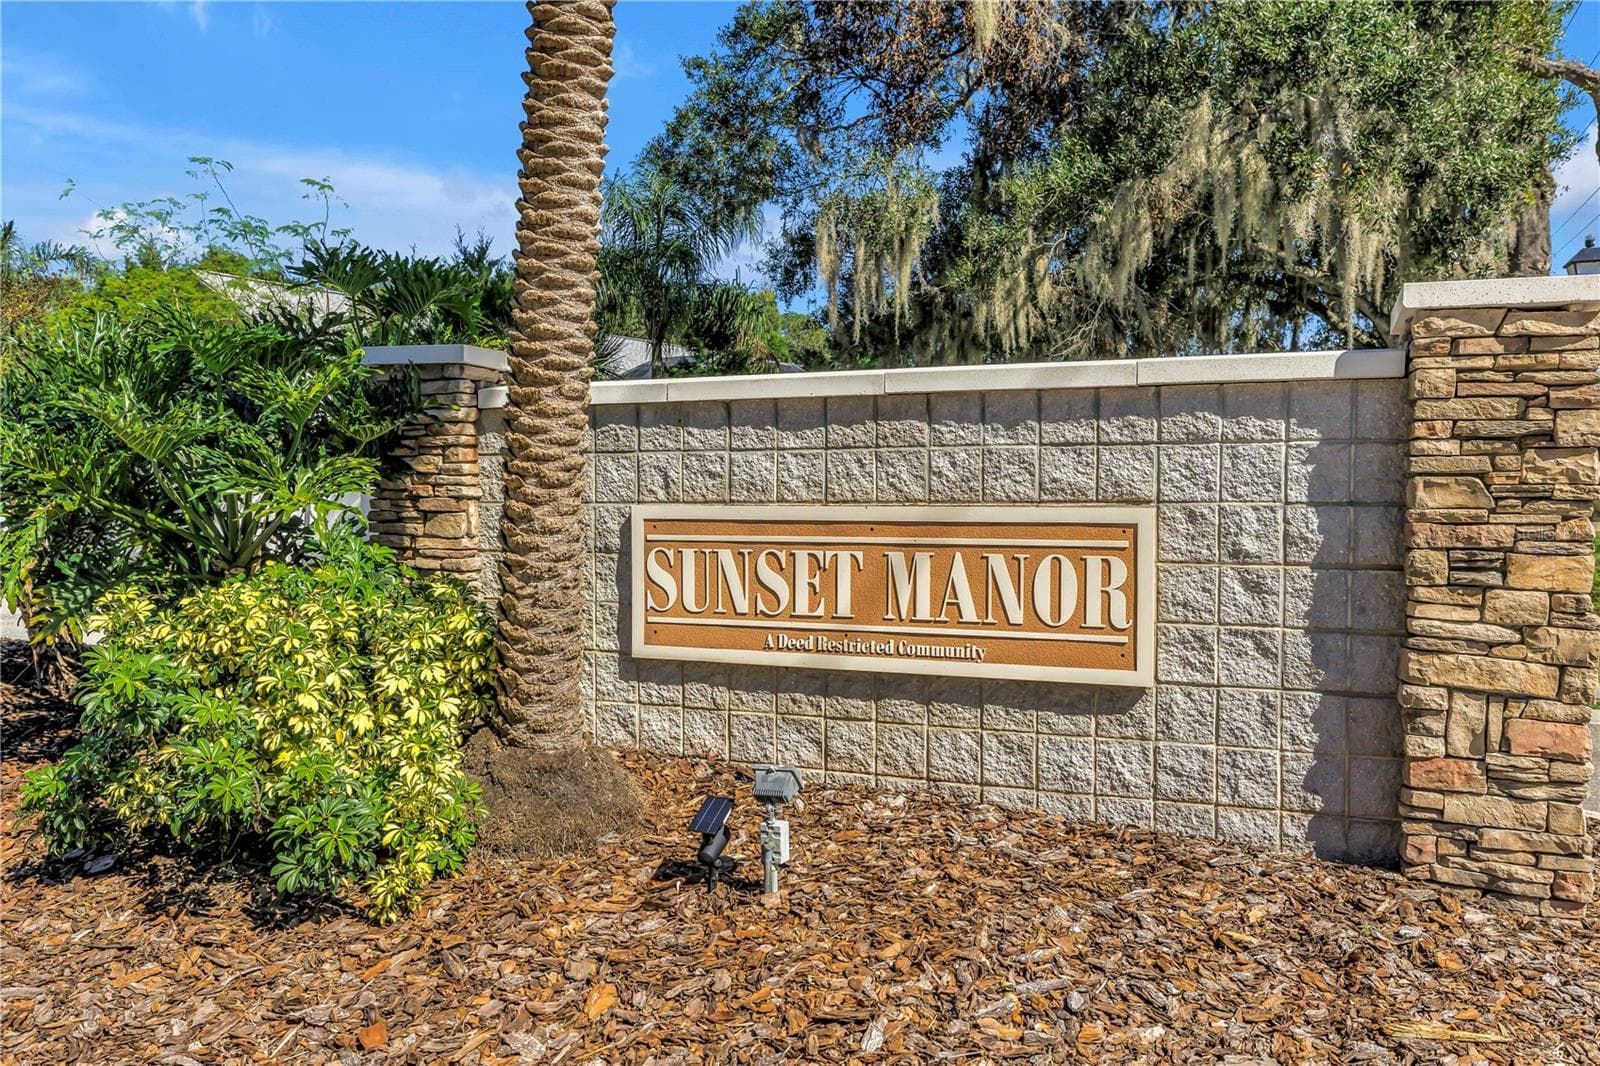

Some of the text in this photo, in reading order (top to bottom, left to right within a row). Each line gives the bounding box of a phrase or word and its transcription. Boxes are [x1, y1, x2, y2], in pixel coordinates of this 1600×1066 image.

[645, 546, 1133, 630] SUNSET MANOR
[764, 633, 986, 663] A Deed Restricted Community
